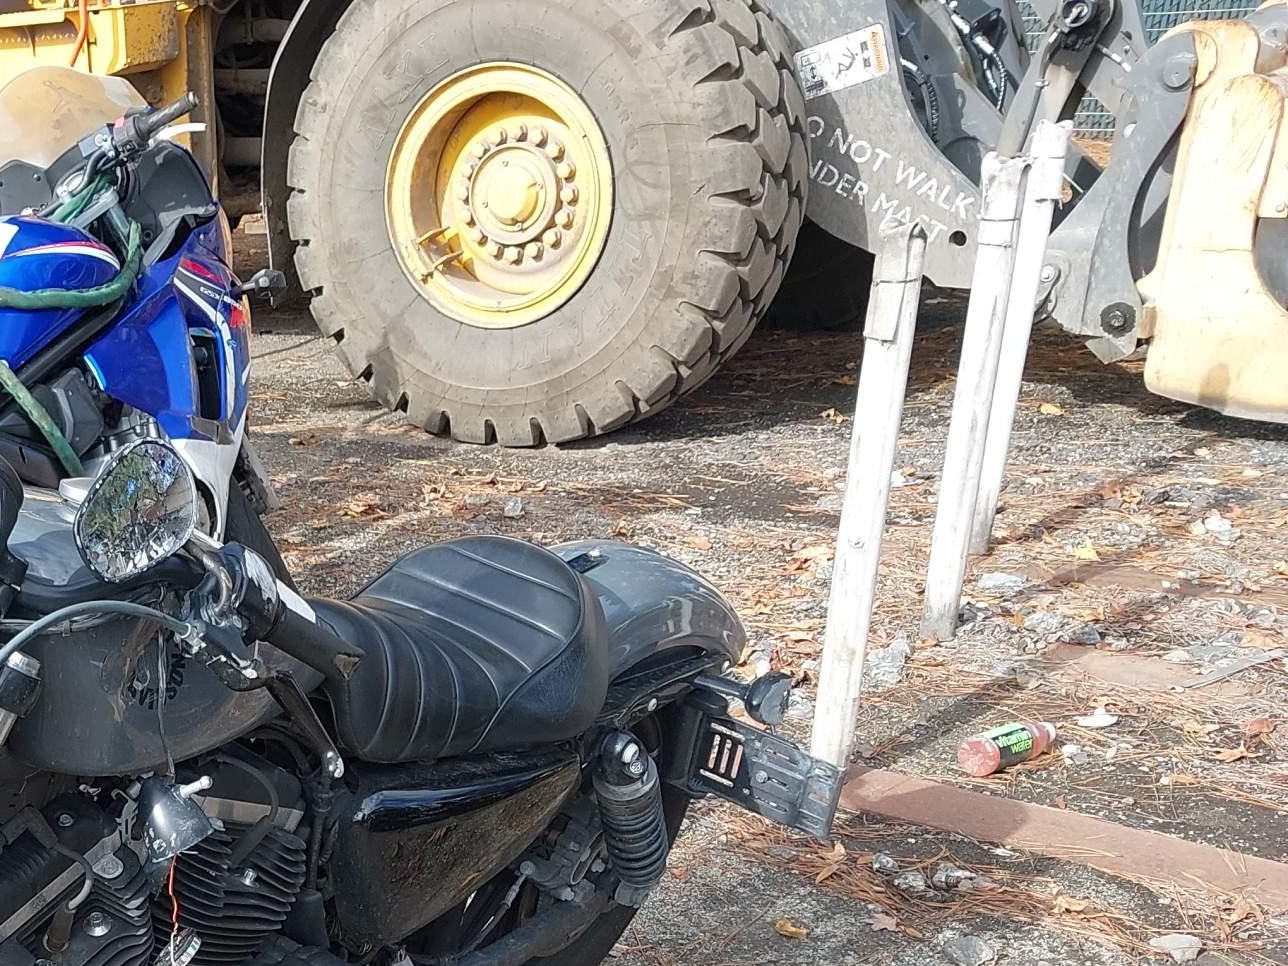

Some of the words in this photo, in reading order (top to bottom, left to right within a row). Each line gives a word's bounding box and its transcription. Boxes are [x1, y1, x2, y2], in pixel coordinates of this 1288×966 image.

[809, 159, 869, 206] NDER
[828, 127, 892, 173] NOT
[895, 160, 976, 220] WALK
[994, 729, 1032, 748] vitamin
[1010, 738, 1033, 754] water
